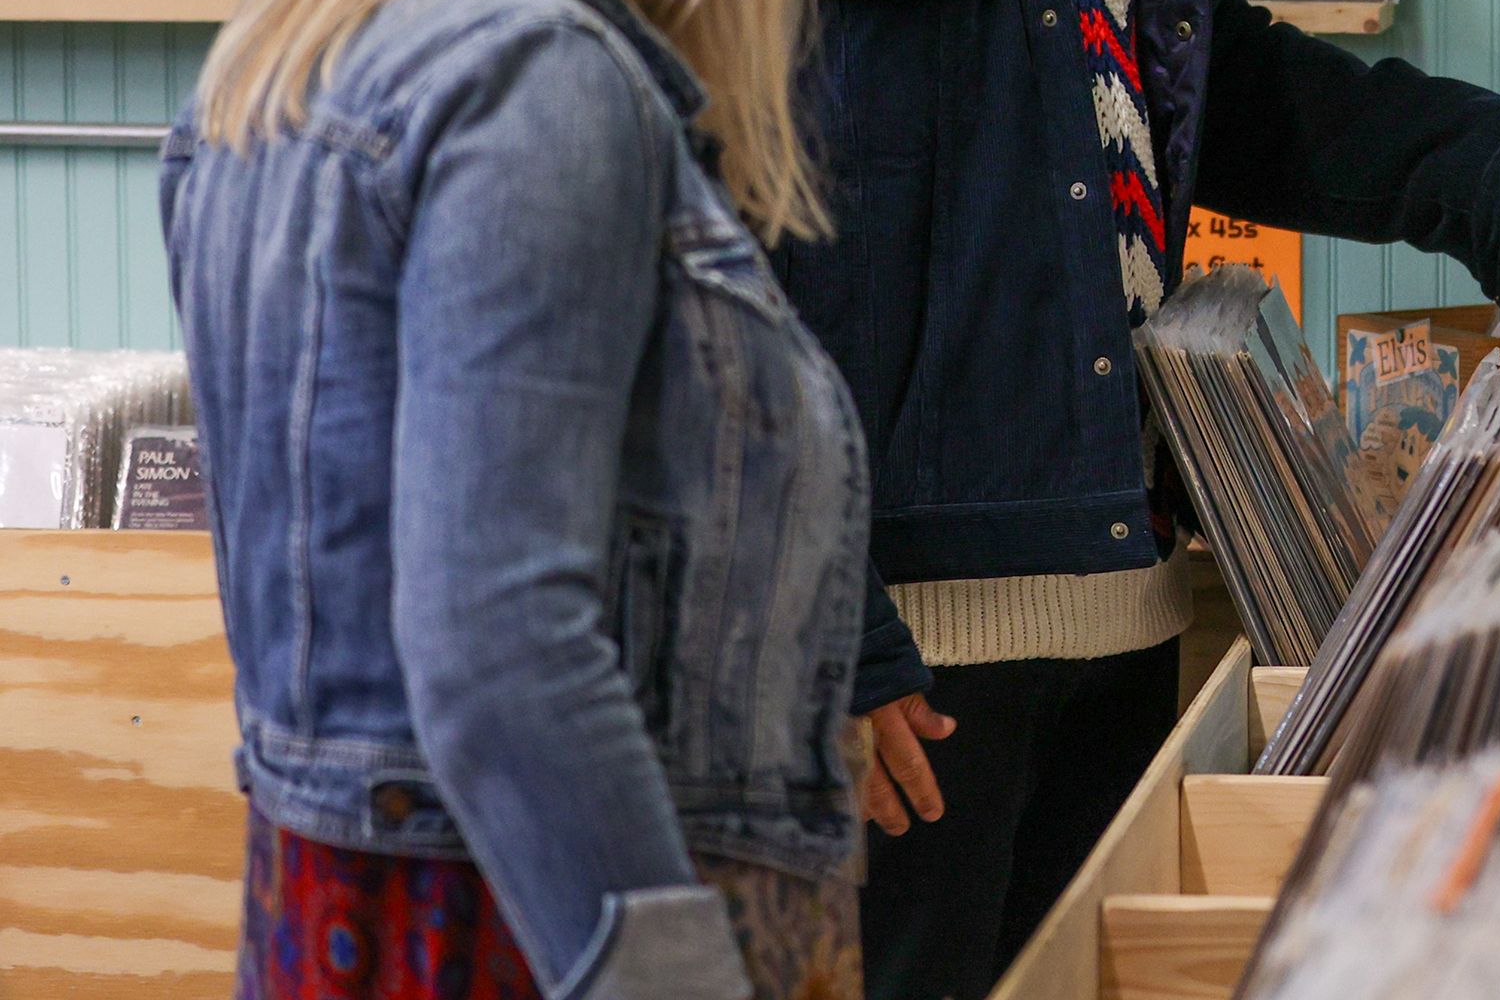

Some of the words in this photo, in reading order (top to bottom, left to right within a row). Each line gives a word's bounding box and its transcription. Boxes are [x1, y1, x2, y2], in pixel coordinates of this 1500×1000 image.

[1210, 217, 1258, 238] 45s
[1377, 333, 1427, 376] Elvis
[138, 451, 177, 465] PAUL
[135, 467, 191, 480] SIMON
